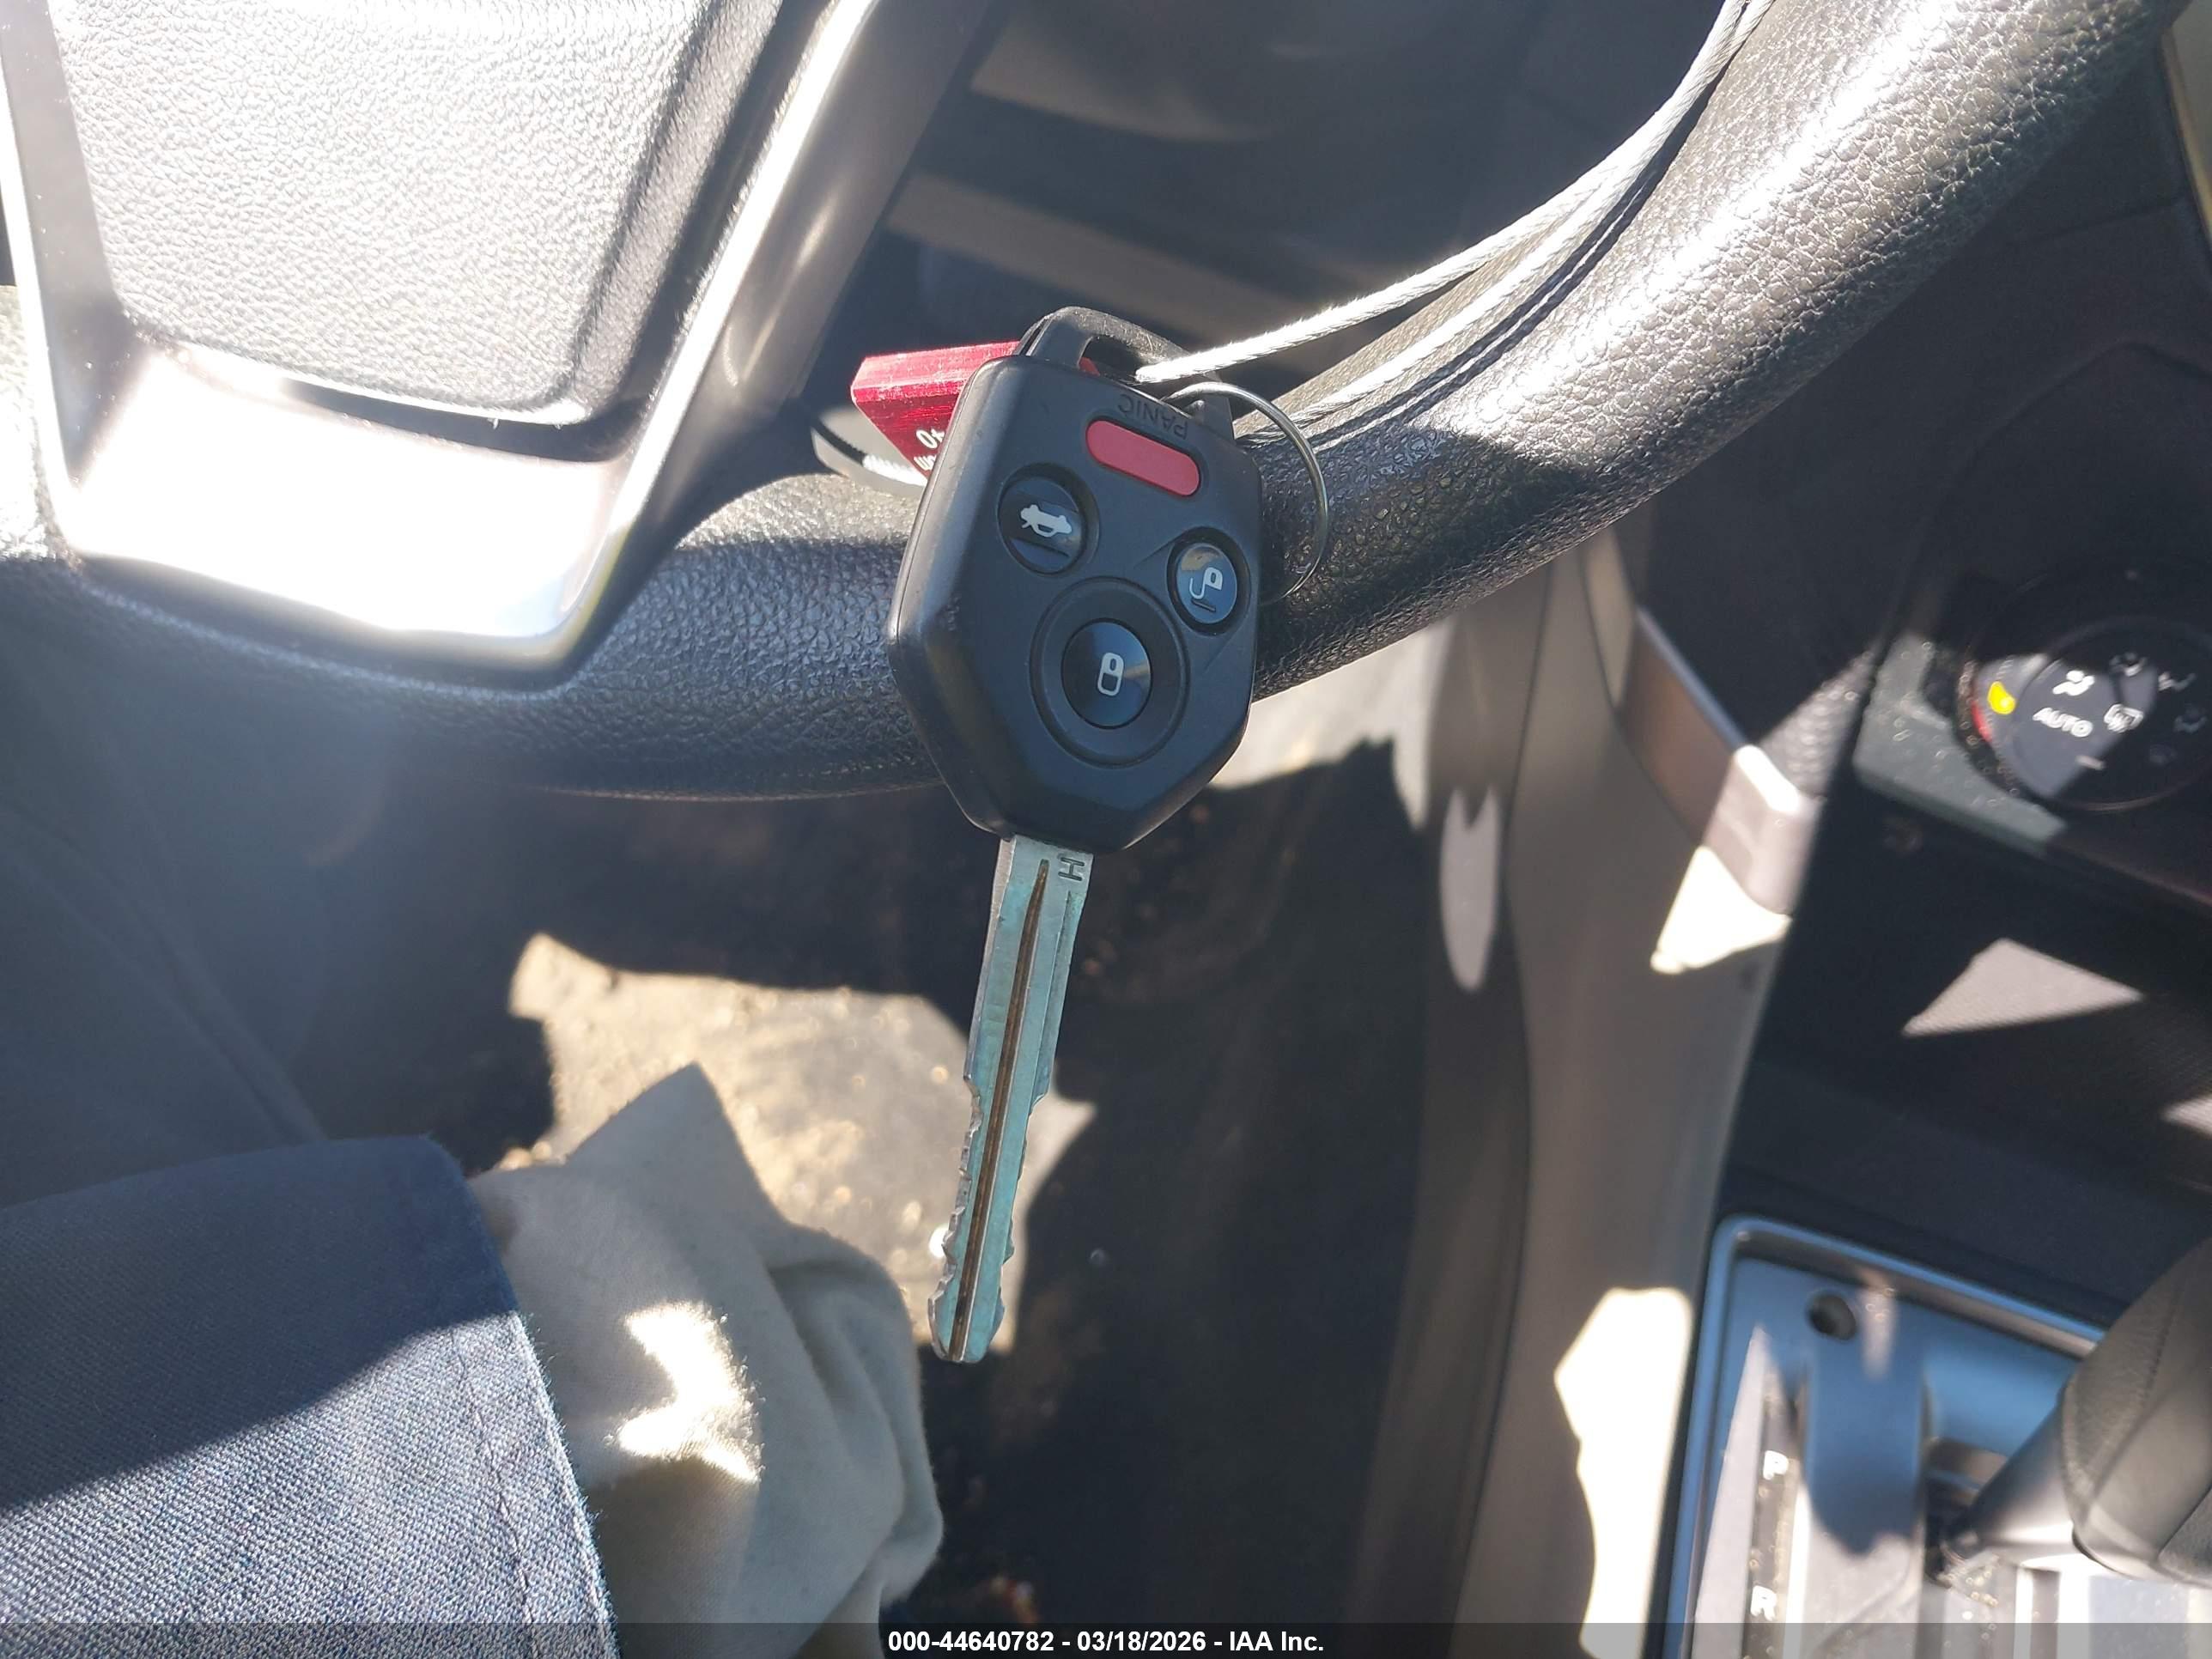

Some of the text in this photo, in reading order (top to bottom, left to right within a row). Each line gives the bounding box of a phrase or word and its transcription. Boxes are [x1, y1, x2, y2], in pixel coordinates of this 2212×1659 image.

[1118, 393, 1188, 441] PANIC
[2033, 707, 2094, 738] AUTO
[1058, 857, 1085, 882] H
[1762, 1449, 1789, 1480] P
[1750, 1585, 1778, 1620] R
